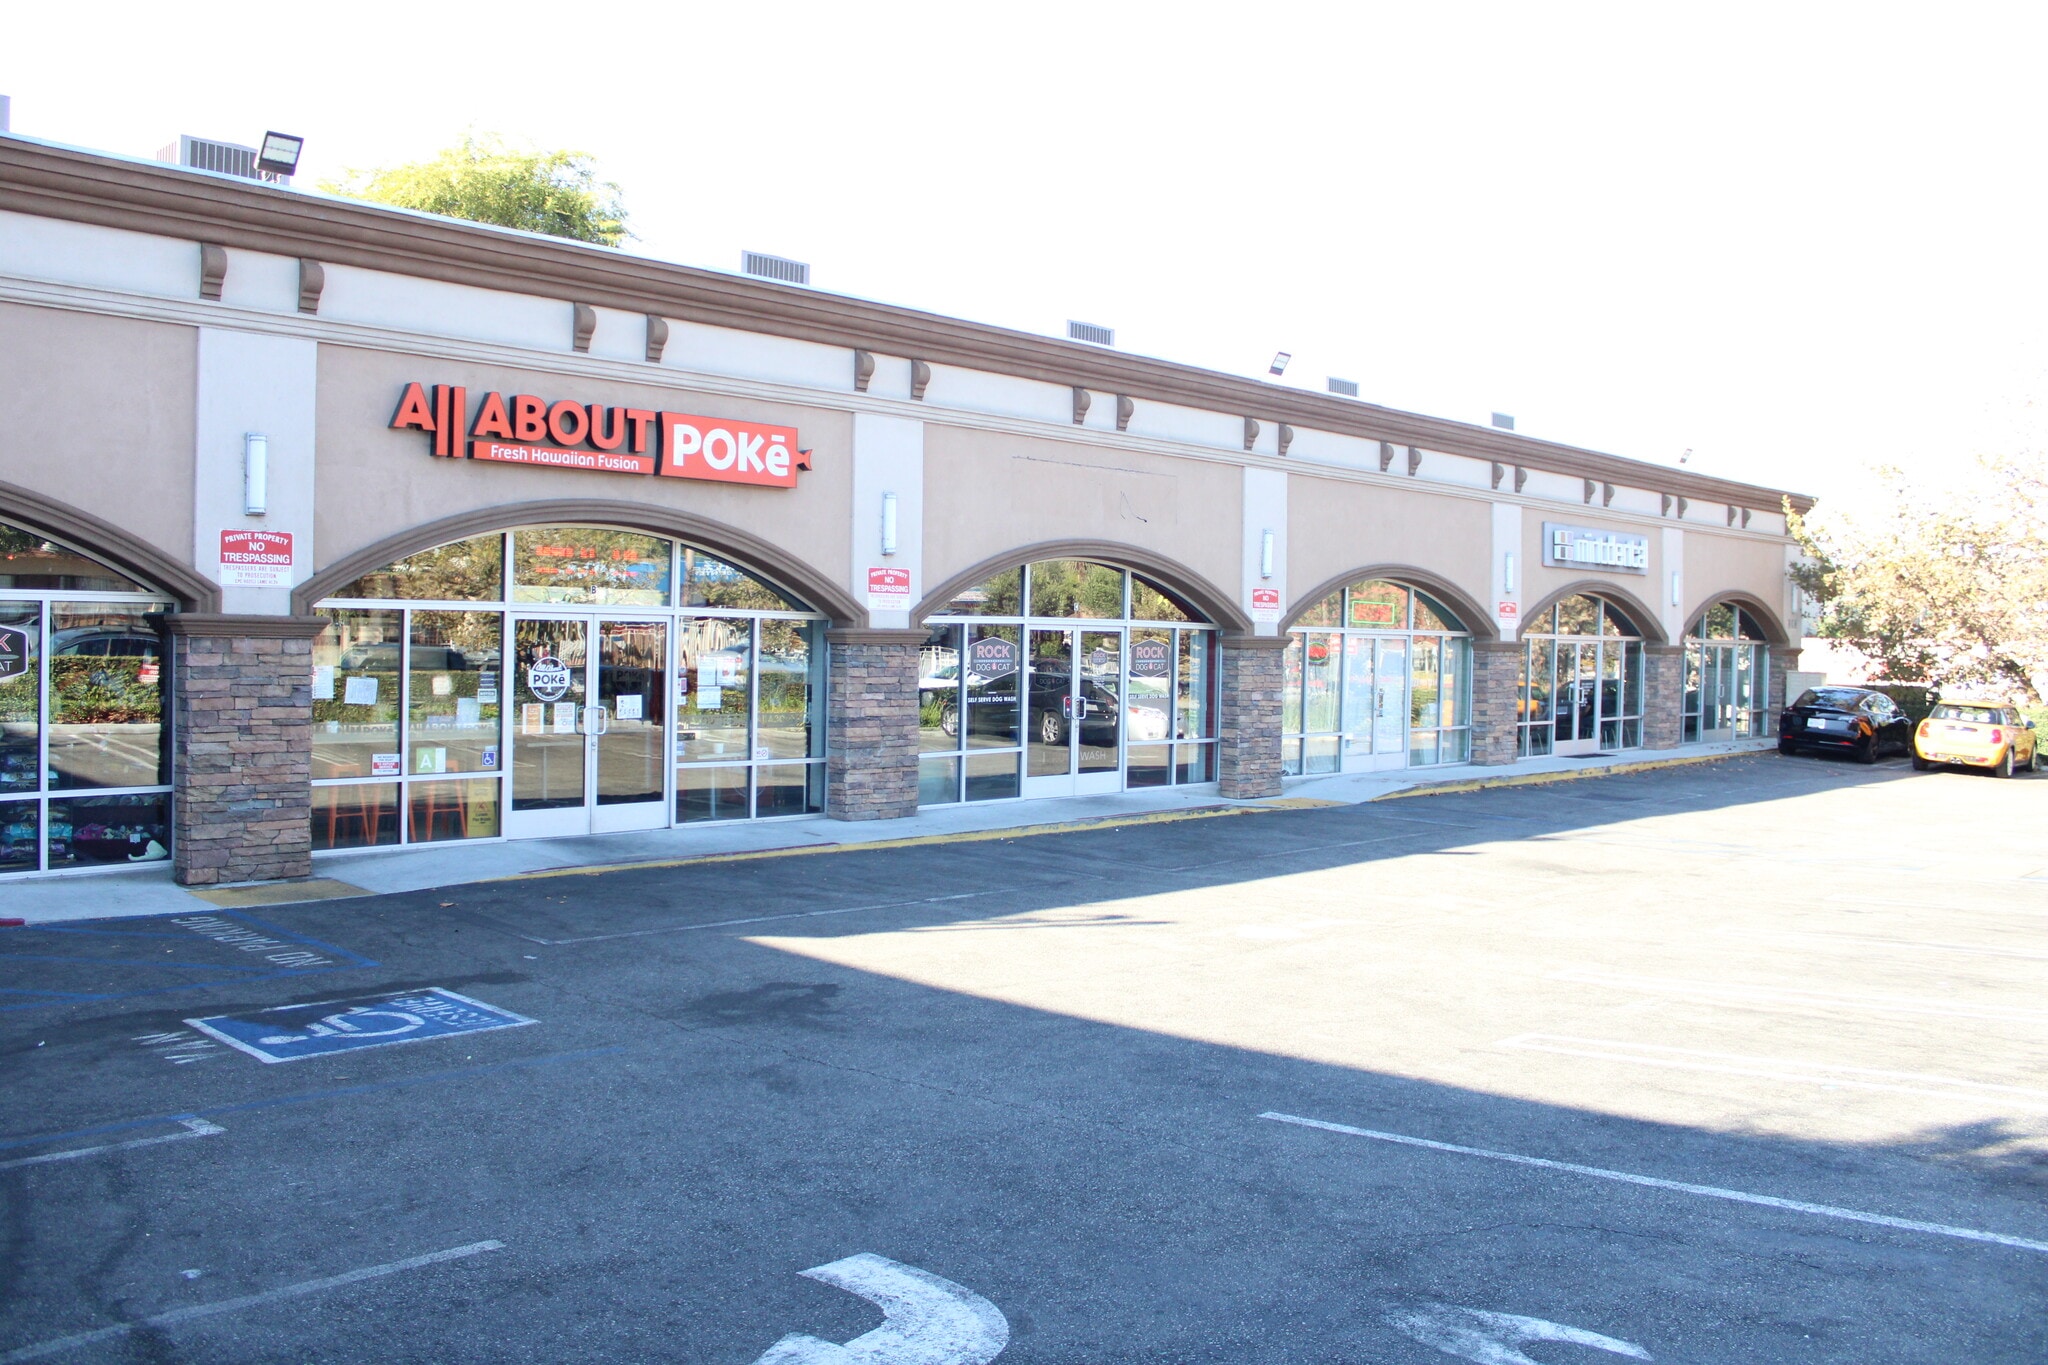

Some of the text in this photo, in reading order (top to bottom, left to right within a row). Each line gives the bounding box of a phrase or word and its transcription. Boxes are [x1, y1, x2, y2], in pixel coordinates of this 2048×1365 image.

[390, 382, 466, 458] All
[469, 391, 656, 453] ABOUT
[490, 445, 639, 471] Fresh Hawaiian Fusion
[225, 533, 289, 546] PRIVATE PROPERTY
[248, 541, 266, 551] NO
[223, 552, 290, 564] TRESPASSING
[884, 576, 895, 584] NO
[870, 584, 909, 593] TRESPASSING
[976, 645, 1010, 658] ROCK
[1136, 646, 1164, 659] ROCK
[975, 663, 991, 671] DOG
[997, 663, 1011, 671] CAT
[1135, 663, 1148, 671] DOG
[420, 754, 432, 768] A
[1080, 750, 1106, 761] WASH
[171, 916, 333, 968] NO PARKING
